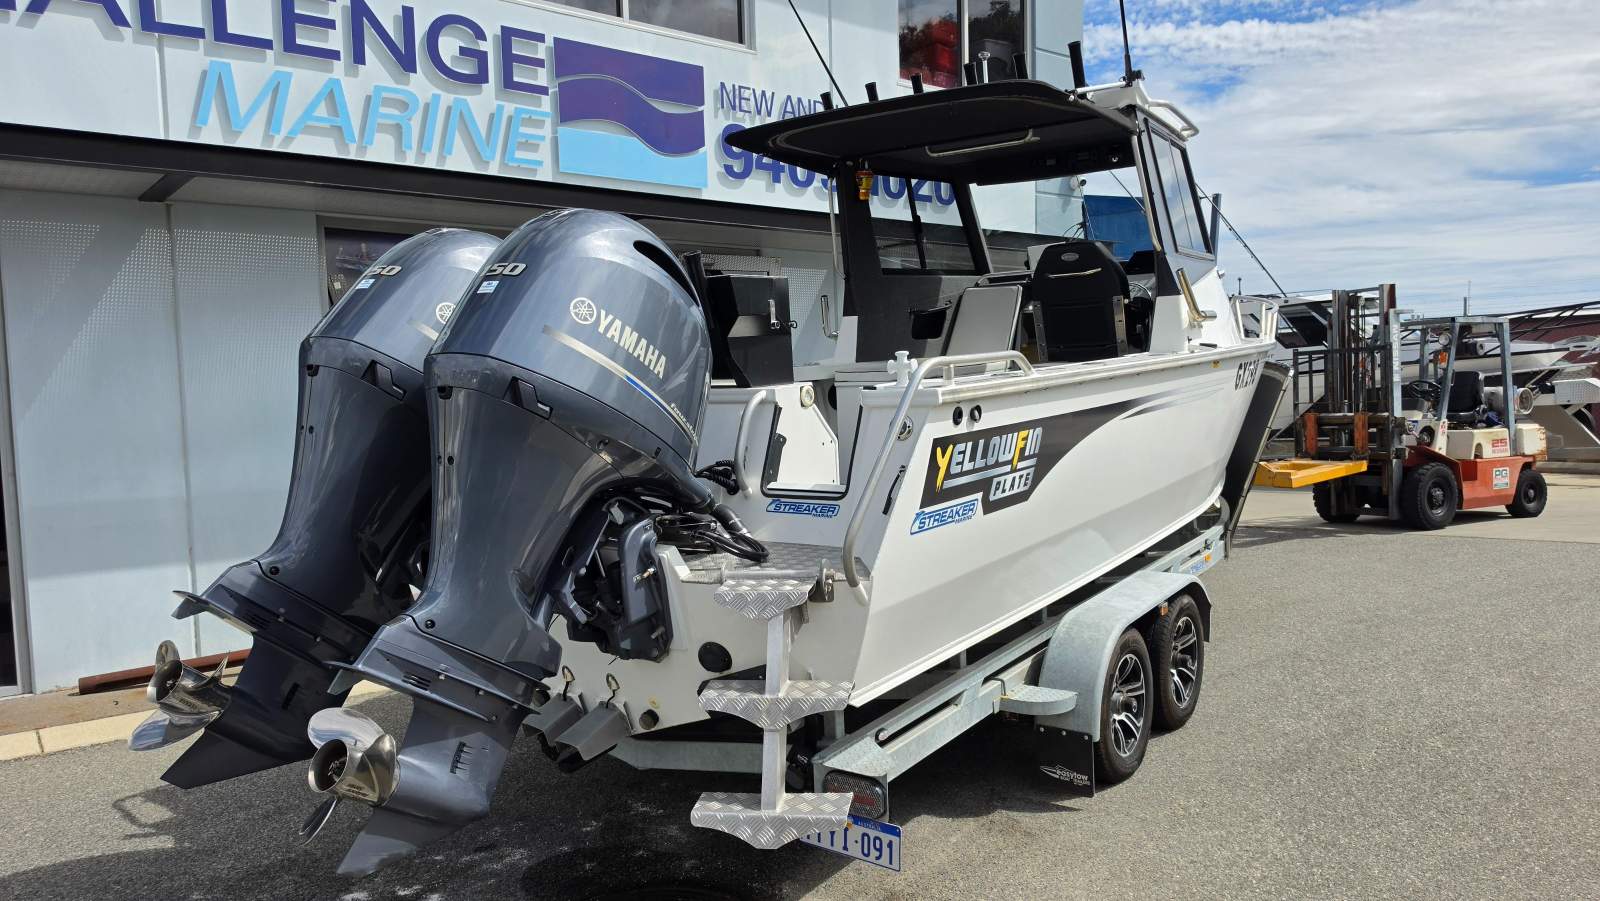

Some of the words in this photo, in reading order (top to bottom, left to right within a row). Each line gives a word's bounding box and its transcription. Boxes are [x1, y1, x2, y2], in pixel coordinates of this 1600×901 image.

[0, 0, 550, 96] LLENGE
[195, 60, 552, 168] MARINE
[720, 81, 775, 118] NEW
[481, 262, 527, 276] 50
[598, 309, 667, 379] YAMAHA
[1491, 438, 1508, 448] 25
[936, 427, 1043, 493] YELLOWFIN
[993, 472, 1031, 497] PLATE
[774, 503, 837, 514] STREAKER
[918, 502, 976, 530] STREAKER
